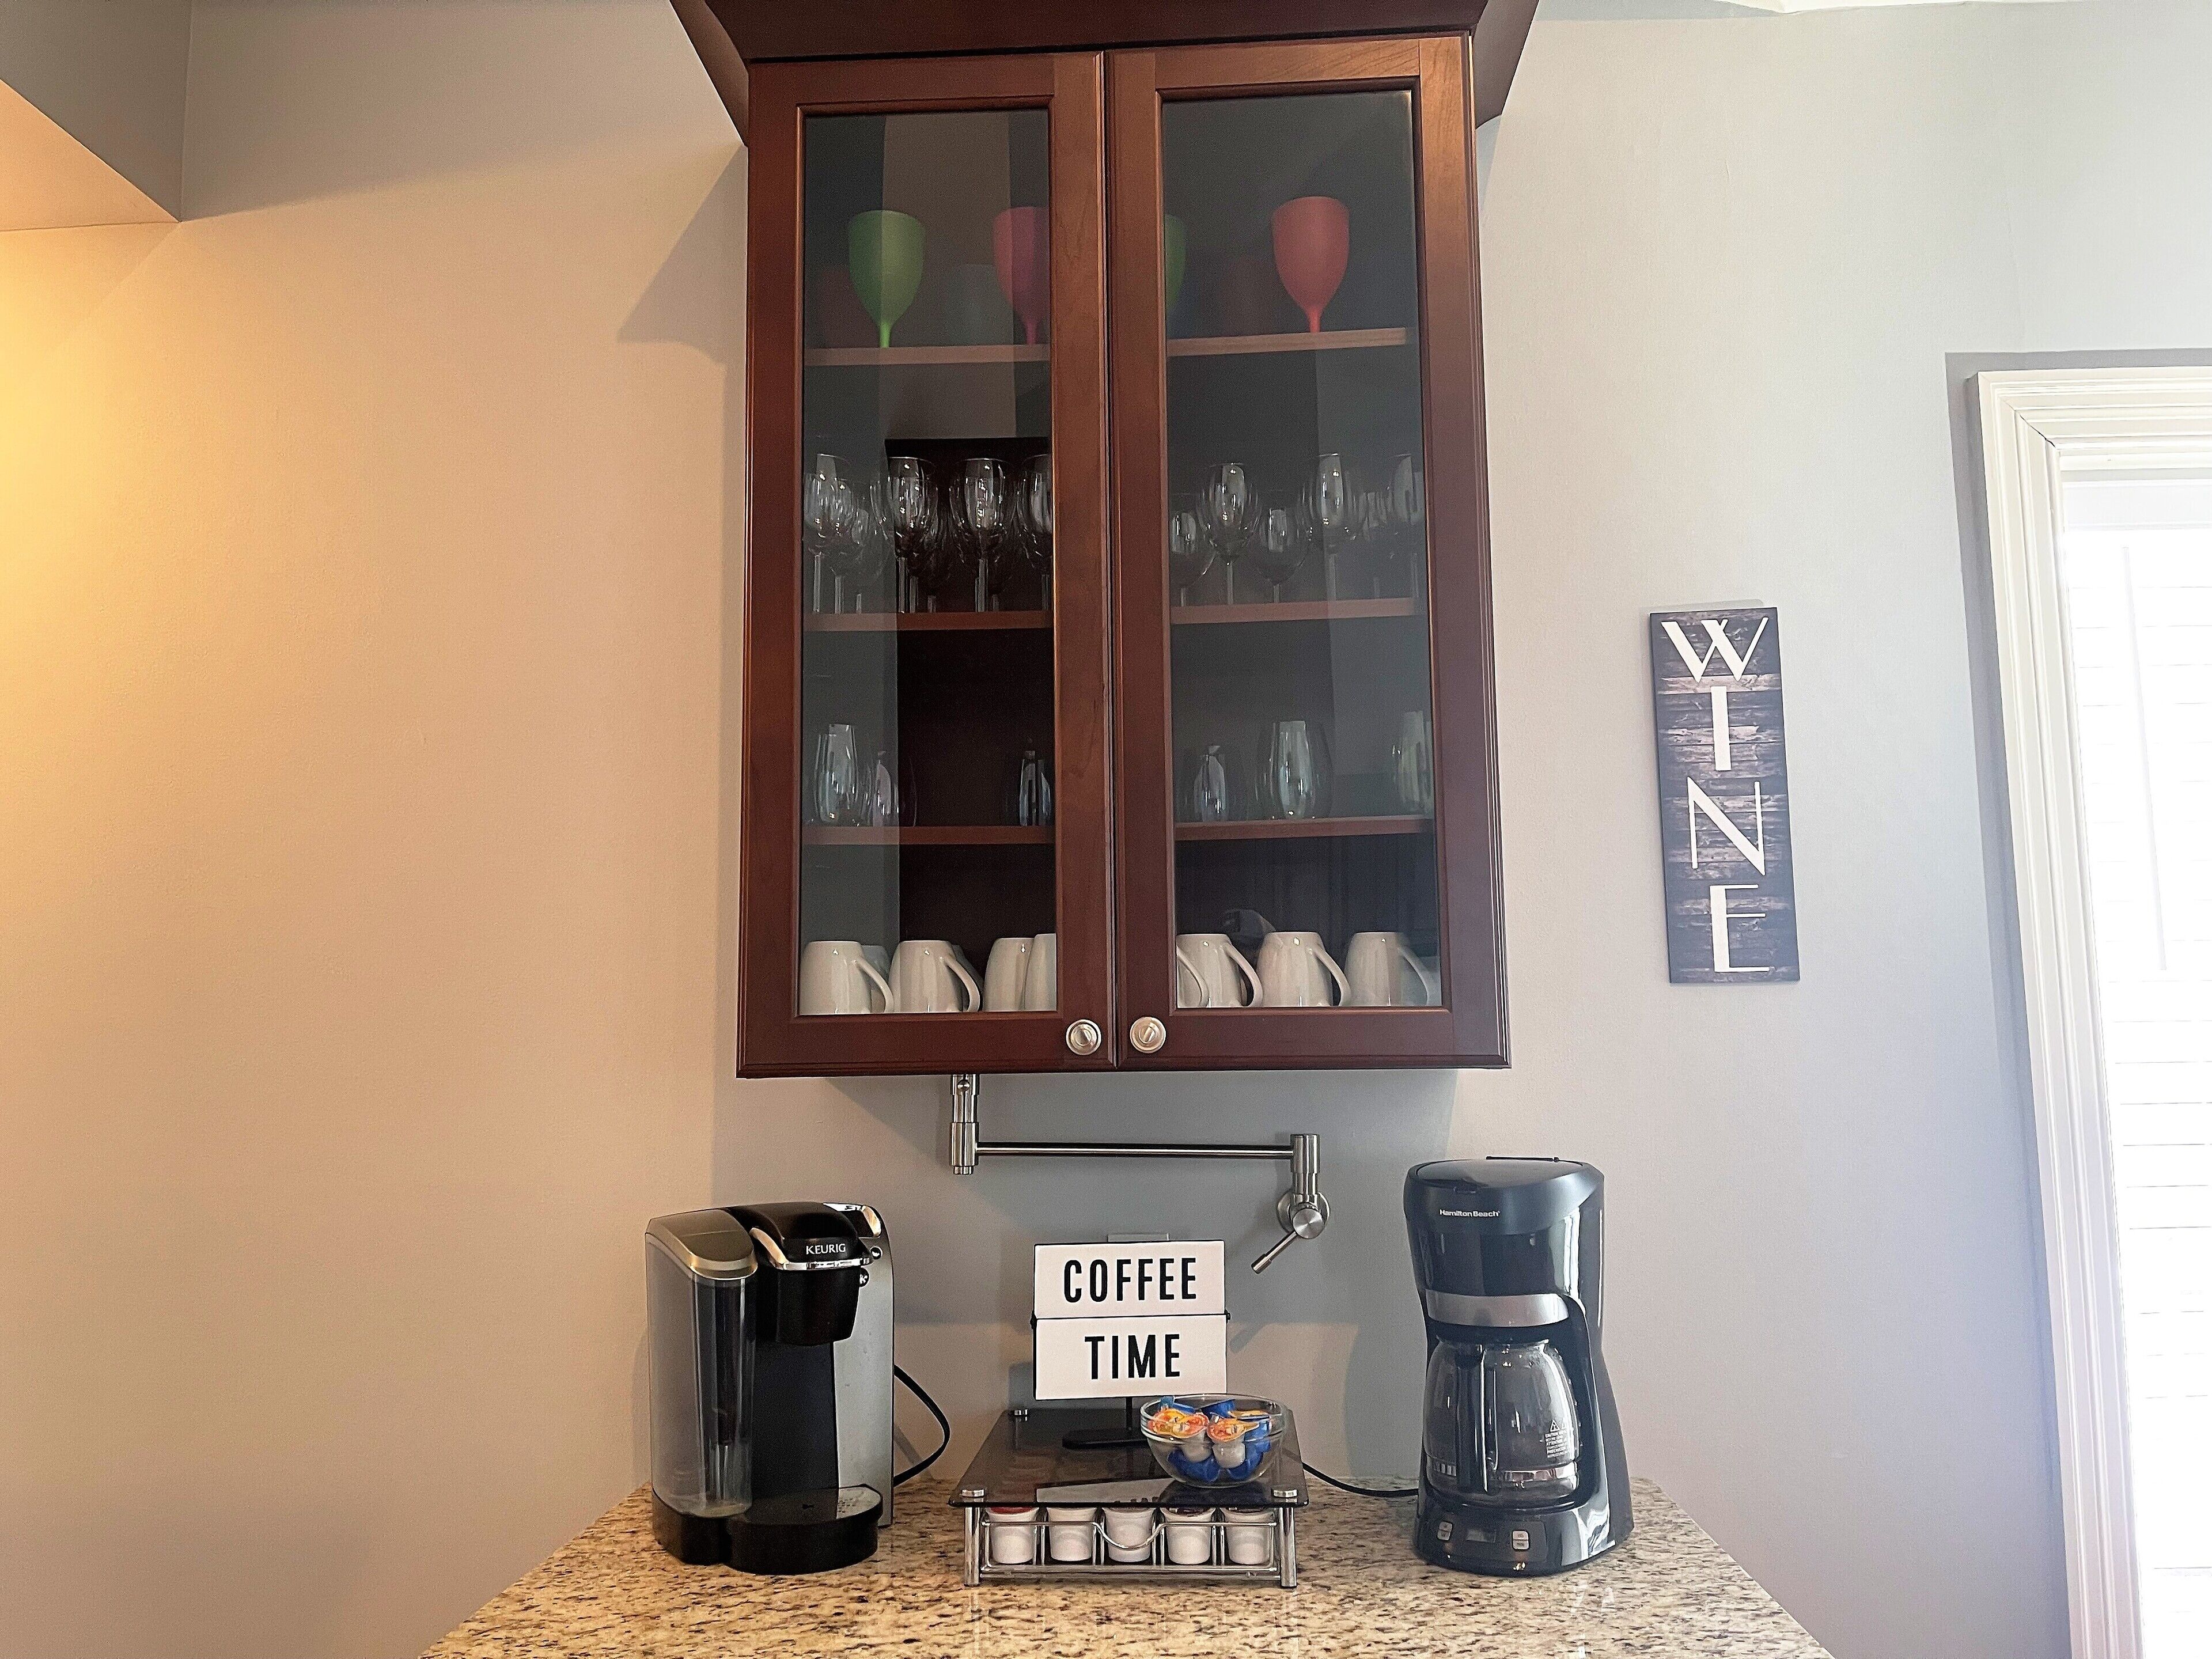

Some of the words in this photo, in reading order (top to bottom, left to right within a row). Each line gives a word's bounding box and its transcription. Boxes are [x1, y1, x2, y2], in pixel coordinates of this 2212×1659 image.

[1661, 617, 1770, 972] WINE
[1440, 1209, 1473, 1217] Hamilton
[806, 1243, 846, 1255] KEURIG
[1064, 1257, 1196, 1303] COFFEE
[1084, 1334, 1180, 1380] TIME
